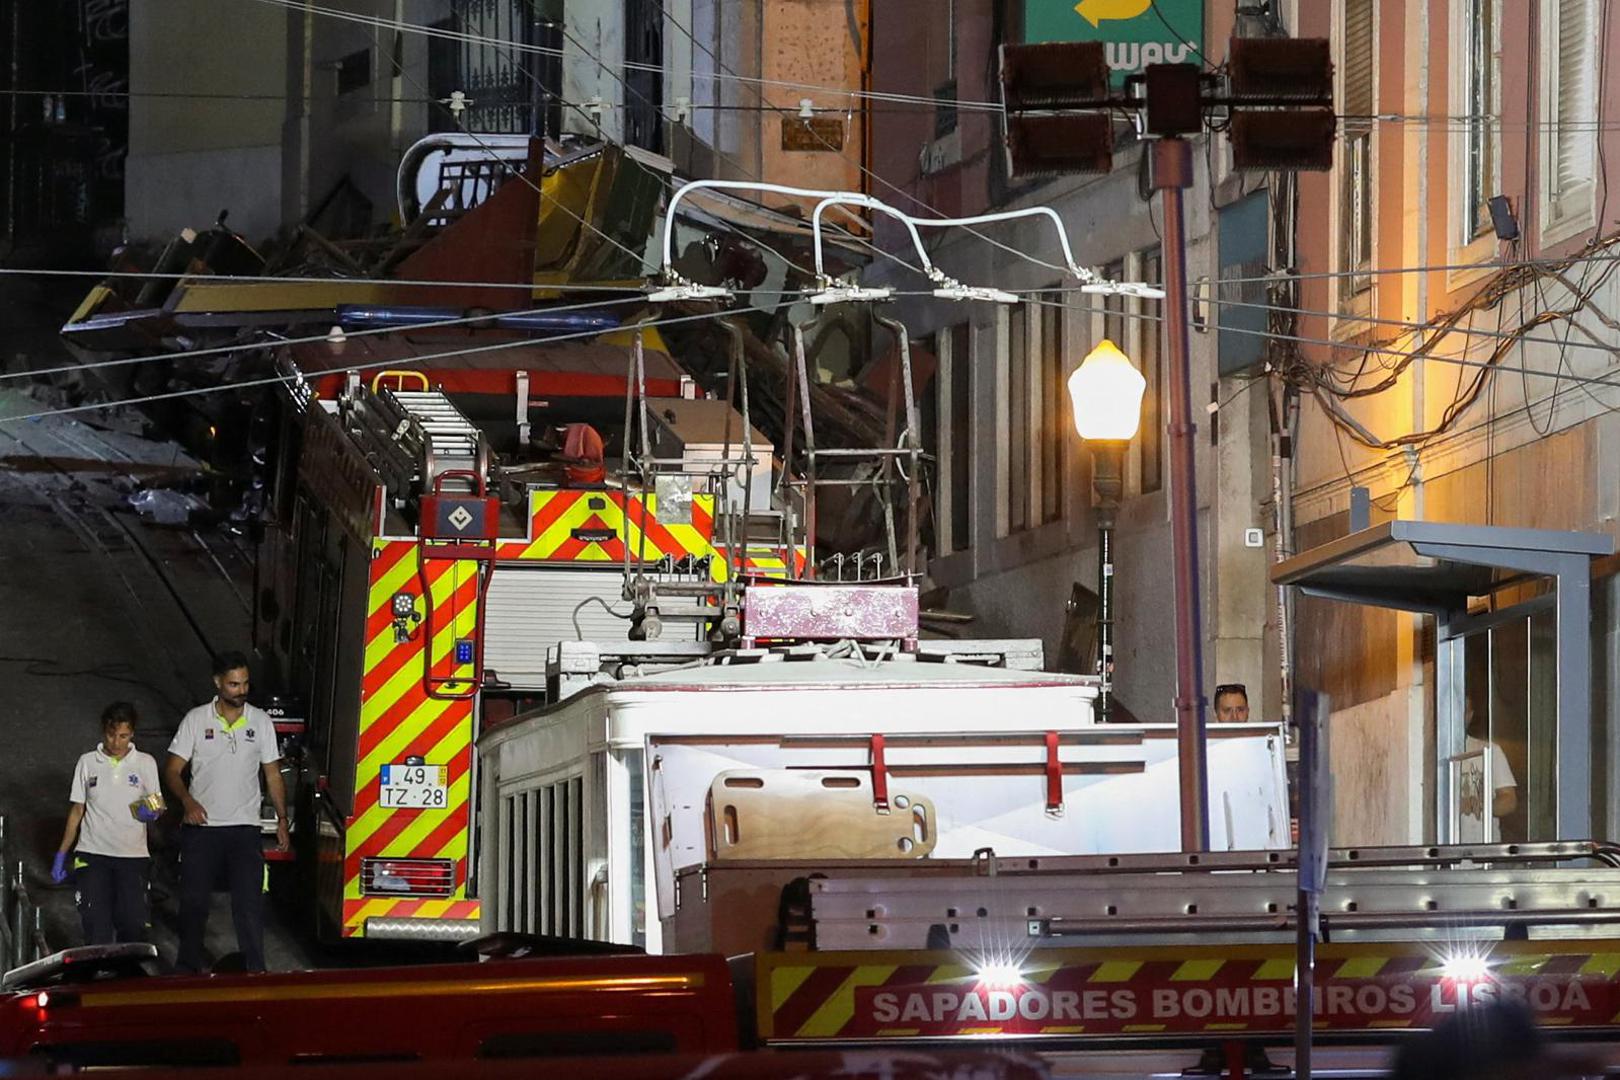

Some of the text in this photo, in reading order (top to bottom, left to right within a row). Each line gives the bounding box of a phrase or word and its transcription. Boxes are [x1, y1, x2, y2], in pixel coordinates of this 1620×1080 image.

[404, 767, 425, 784] 49
[872, 989, 1138, 1022] SAPADORES
[1153, 984, 1416, 1018] BOMBEIROS
